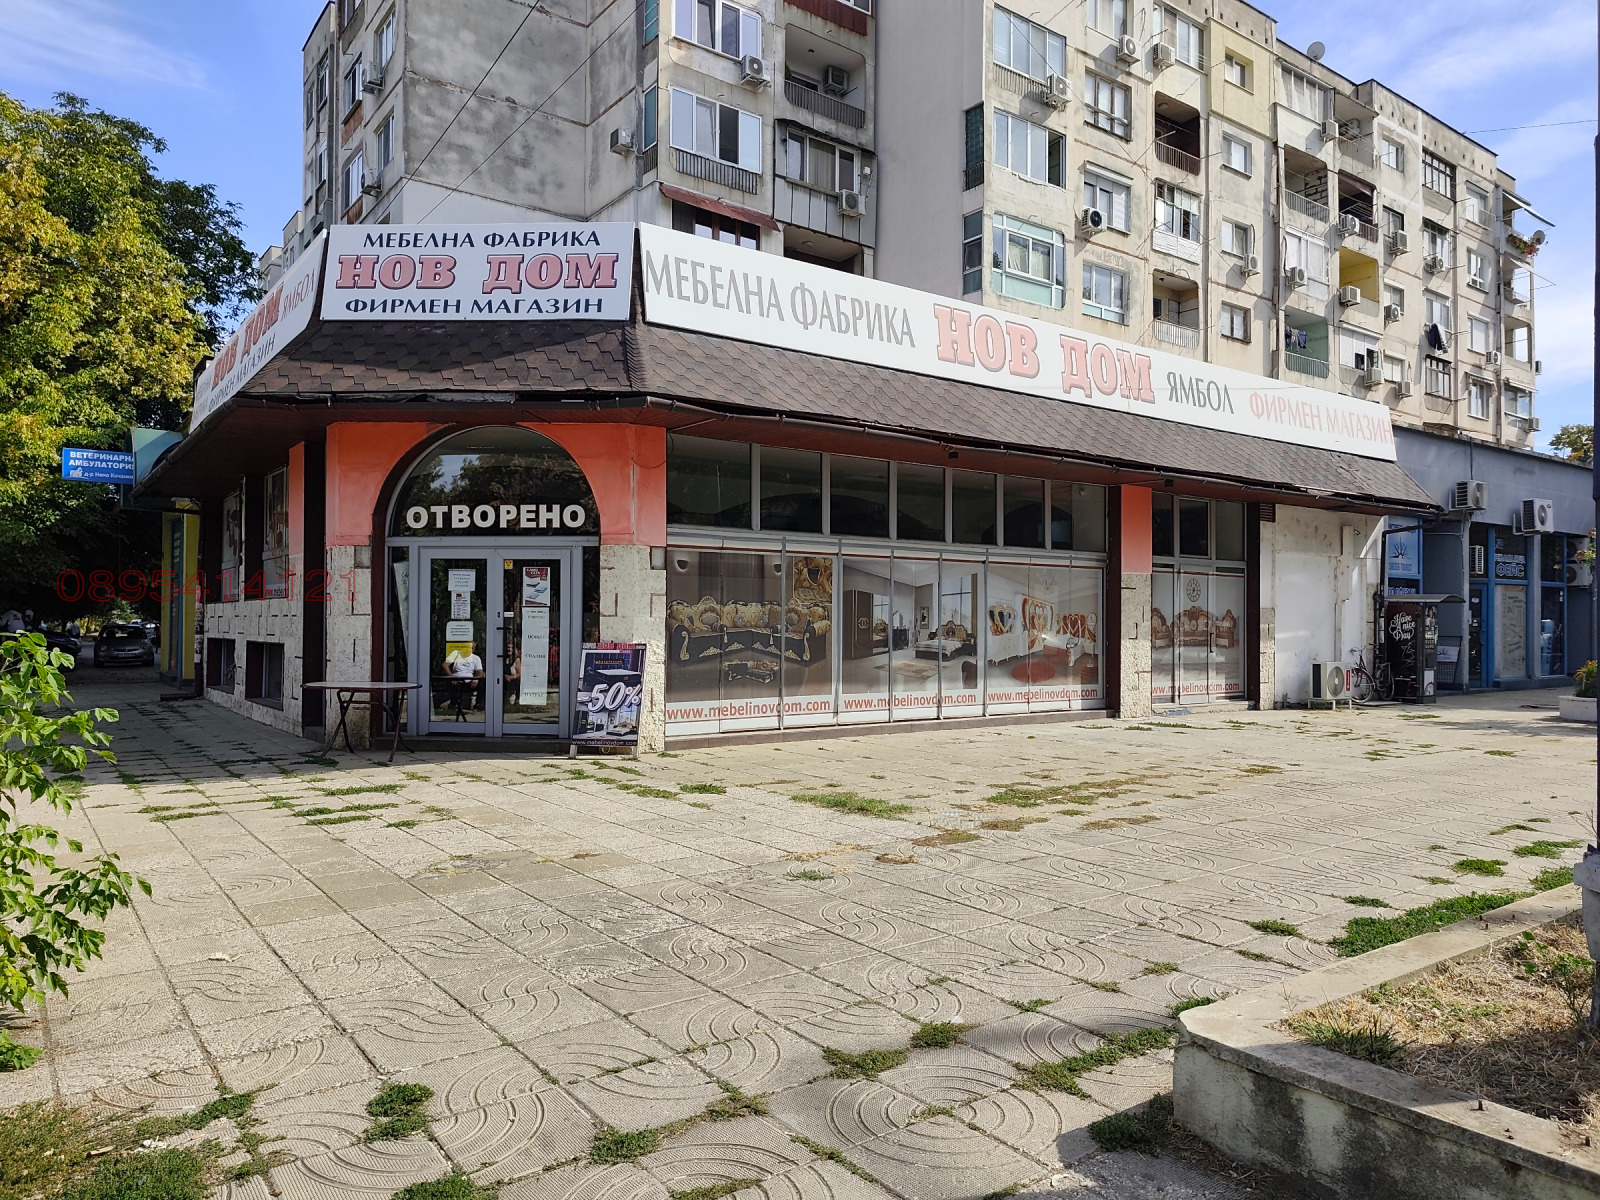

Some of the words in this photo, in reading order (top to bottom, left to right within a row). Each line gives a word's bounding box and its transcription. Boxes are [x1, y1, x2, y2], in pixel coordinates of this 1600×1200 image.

[363, 232, 475, 248] МЕБЕЛНА
[483, 230, 601, 247] ФАБРИКА
[335, 254, 457, 290] НОВ
[482, 252, 619, 294] ДОМ
[345, 298, 461, 314] ФИРМЕН
[470, 298, 603, 314] МАГАЗИН
[241, 281, 285, 363] ДОМ
[281, 268, 315, 321] ЯМБОЛ
[645, 249, 785, 322] МЕБЕЛНА
[790, 281, 916, 348] ФАБРИКА
[933, 303, 1040, 379] НОВ
[1059, 333, 1155, 404] ДОМ
[1166, 371, 1234, 415] ЯМБОЛ
[1250, 391, 1323, 432] ФИРМЕН
[1326, 406, 1394, 444] МАГАЗИН
[405, 504, 586, 529] ОТВОРЕНО
[1390, 612, 1413, 627] Have
[1402, 621, 1416, 630] nice
[1393, 629, 1415, 641] Day
[988, 688, 1098, 702] www.mebelinovdom.com
